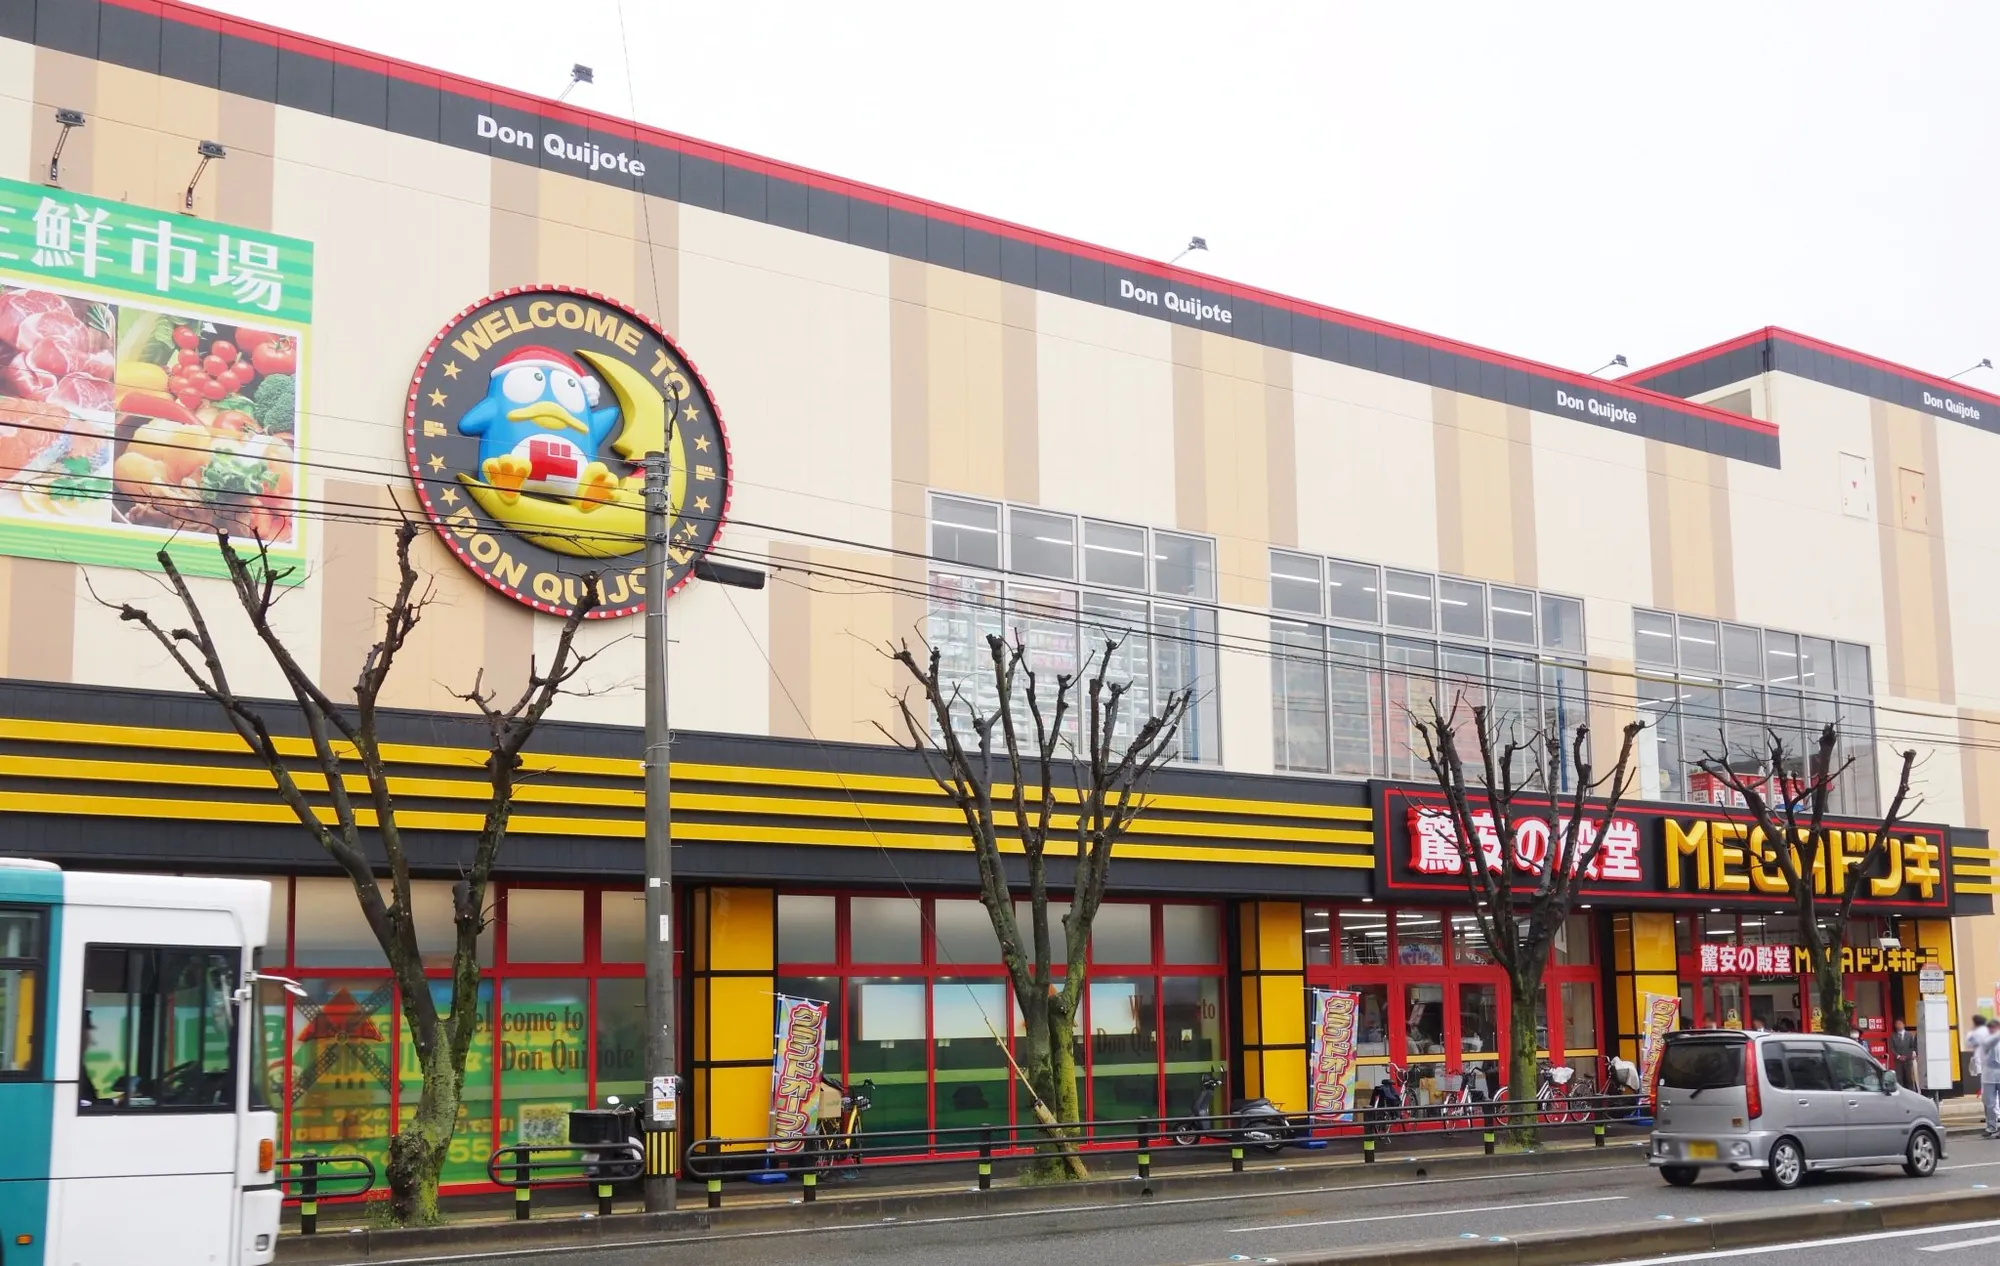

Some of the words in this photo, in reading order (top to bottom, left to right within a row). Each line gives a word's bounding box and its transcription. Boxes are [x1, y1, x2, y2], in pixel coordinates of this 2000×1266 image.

[476, 114, 533, 149] Don
[544, 134, 646, 176] Quijote
[1120, 279, 1158, 305] Don
[1164, 291, 1232, 323] Quijote
[451, 301, 644, 362] WELCOME
[650, 349, 691, 401] TO
[1557, 390, 1584, 411] Don
[1588, 398, 1637, 424] Quijote
[1923, 391, 1943, 409] Don
[1945, 398, 1980, 420] Quijote
[446, 506, 528, 588] DON
[533, 534, 695, 607] QUIJOE
[1700, 944, 1790, 973] 驚安の殿堂
[474, 1001, 557, 1032] elcome
[564, 1006, 584, 1032] to
[1202, 999, 1216, 1019] to
[501, 1040, 543, 1071] Don
[1315, 998, 1354, 1117] グランドオープン
[775, 1007, 822, 1150] グランドオープン
